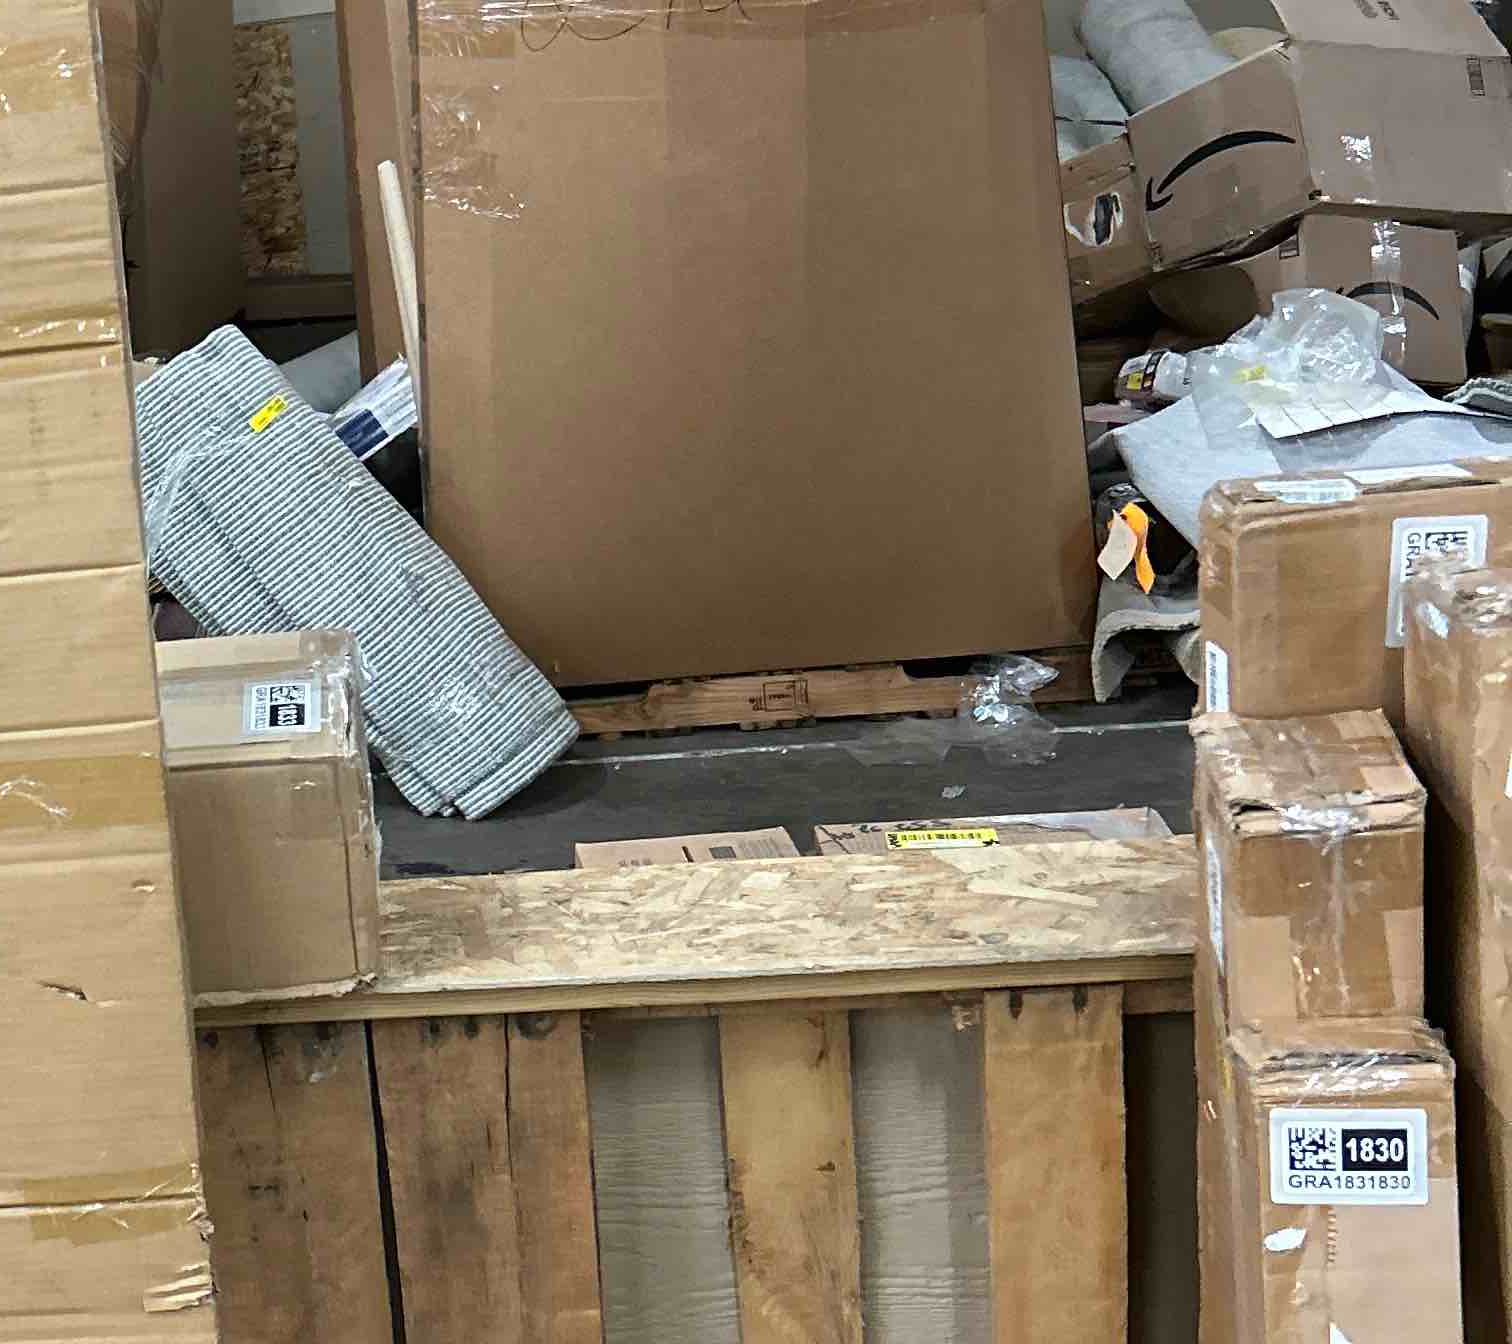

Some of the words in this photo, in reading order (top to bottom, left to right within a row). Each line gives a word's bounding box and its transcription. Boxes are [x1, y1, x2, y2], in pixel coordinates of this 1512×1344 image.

[277, 704, 298, 726] 1833
[1345, 1137, 1405, 1163] 1830
[1288, 1174, 1412, 1190] GRA1831830
